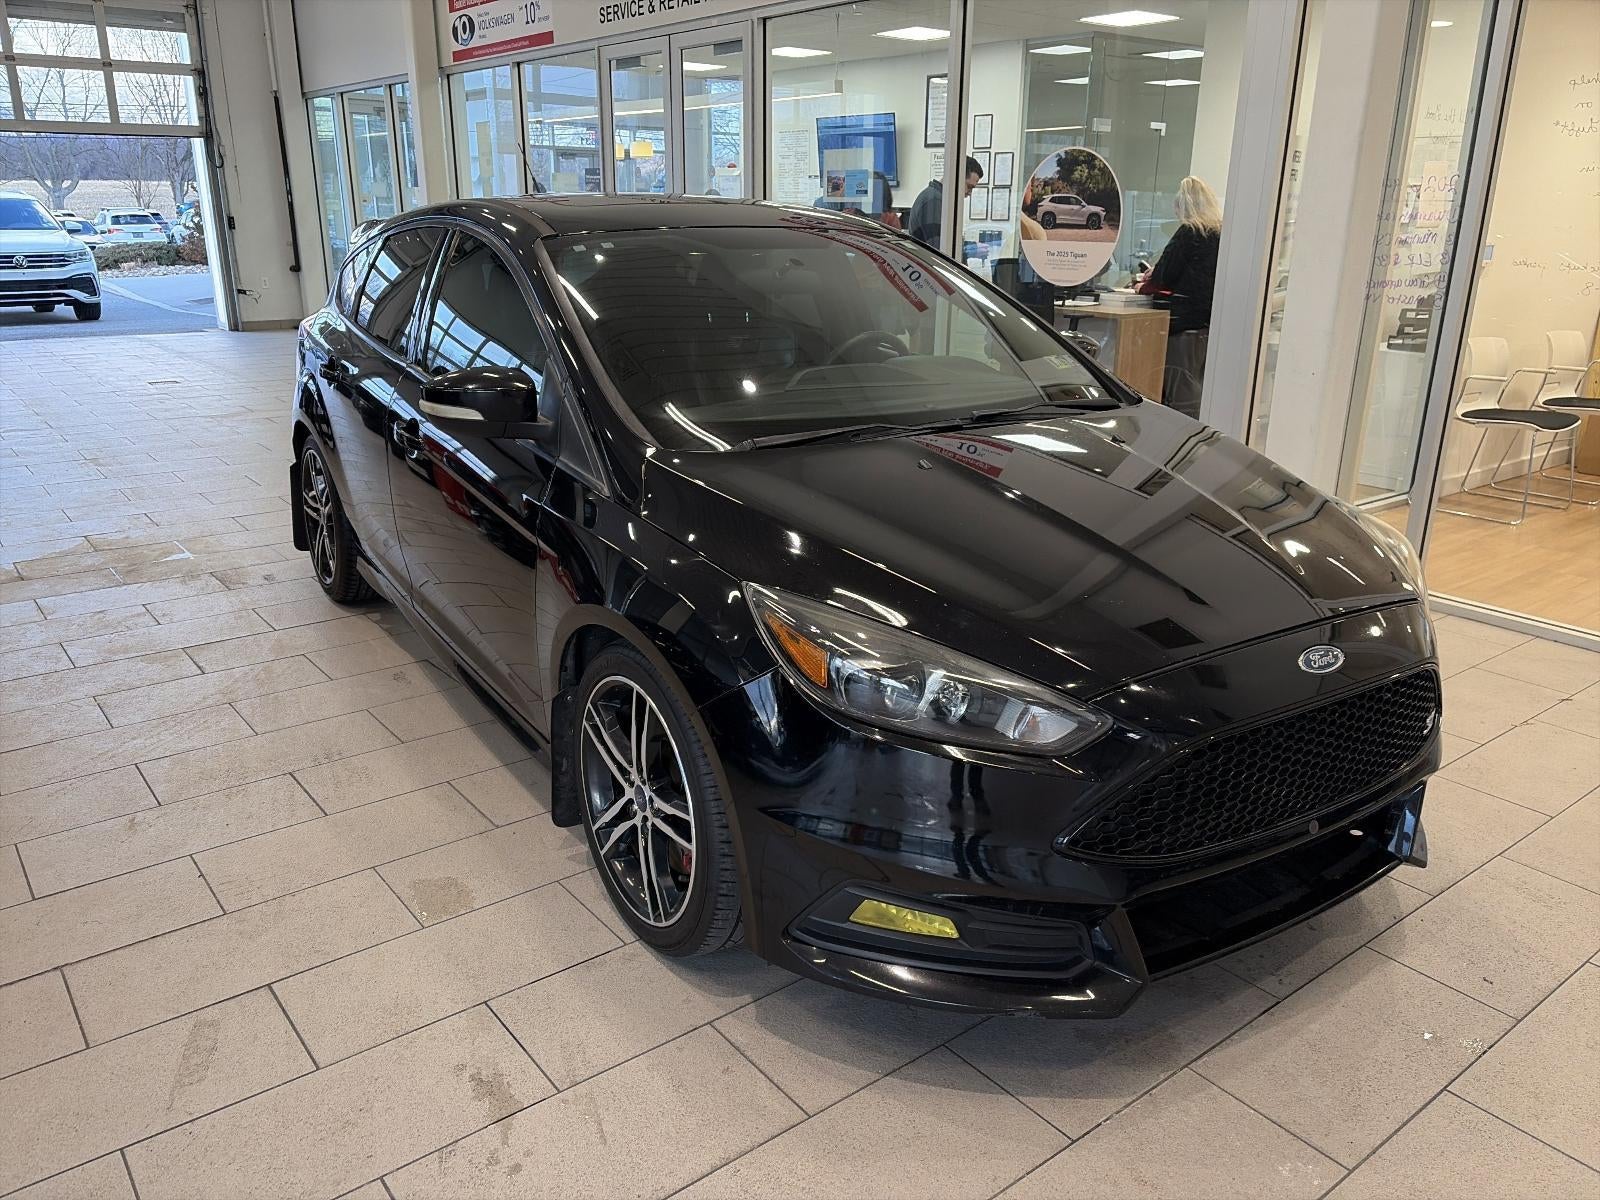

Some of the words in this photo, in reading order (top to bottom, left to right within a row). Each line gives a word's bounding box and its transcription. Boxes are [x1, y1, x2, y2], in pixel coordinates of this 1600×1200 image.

[599, 0, 645, 23] SERVICE
[648, 0, 656, 14] &
[659, 0, 701, 12] RET
[477, 12, 515, 31] VOLKSWAGEN
[1055, 250, 1069, 258] 2025
[1069, 251, 1087, 259] Tiguan
[1309, 650, 1335, 668] Ford
